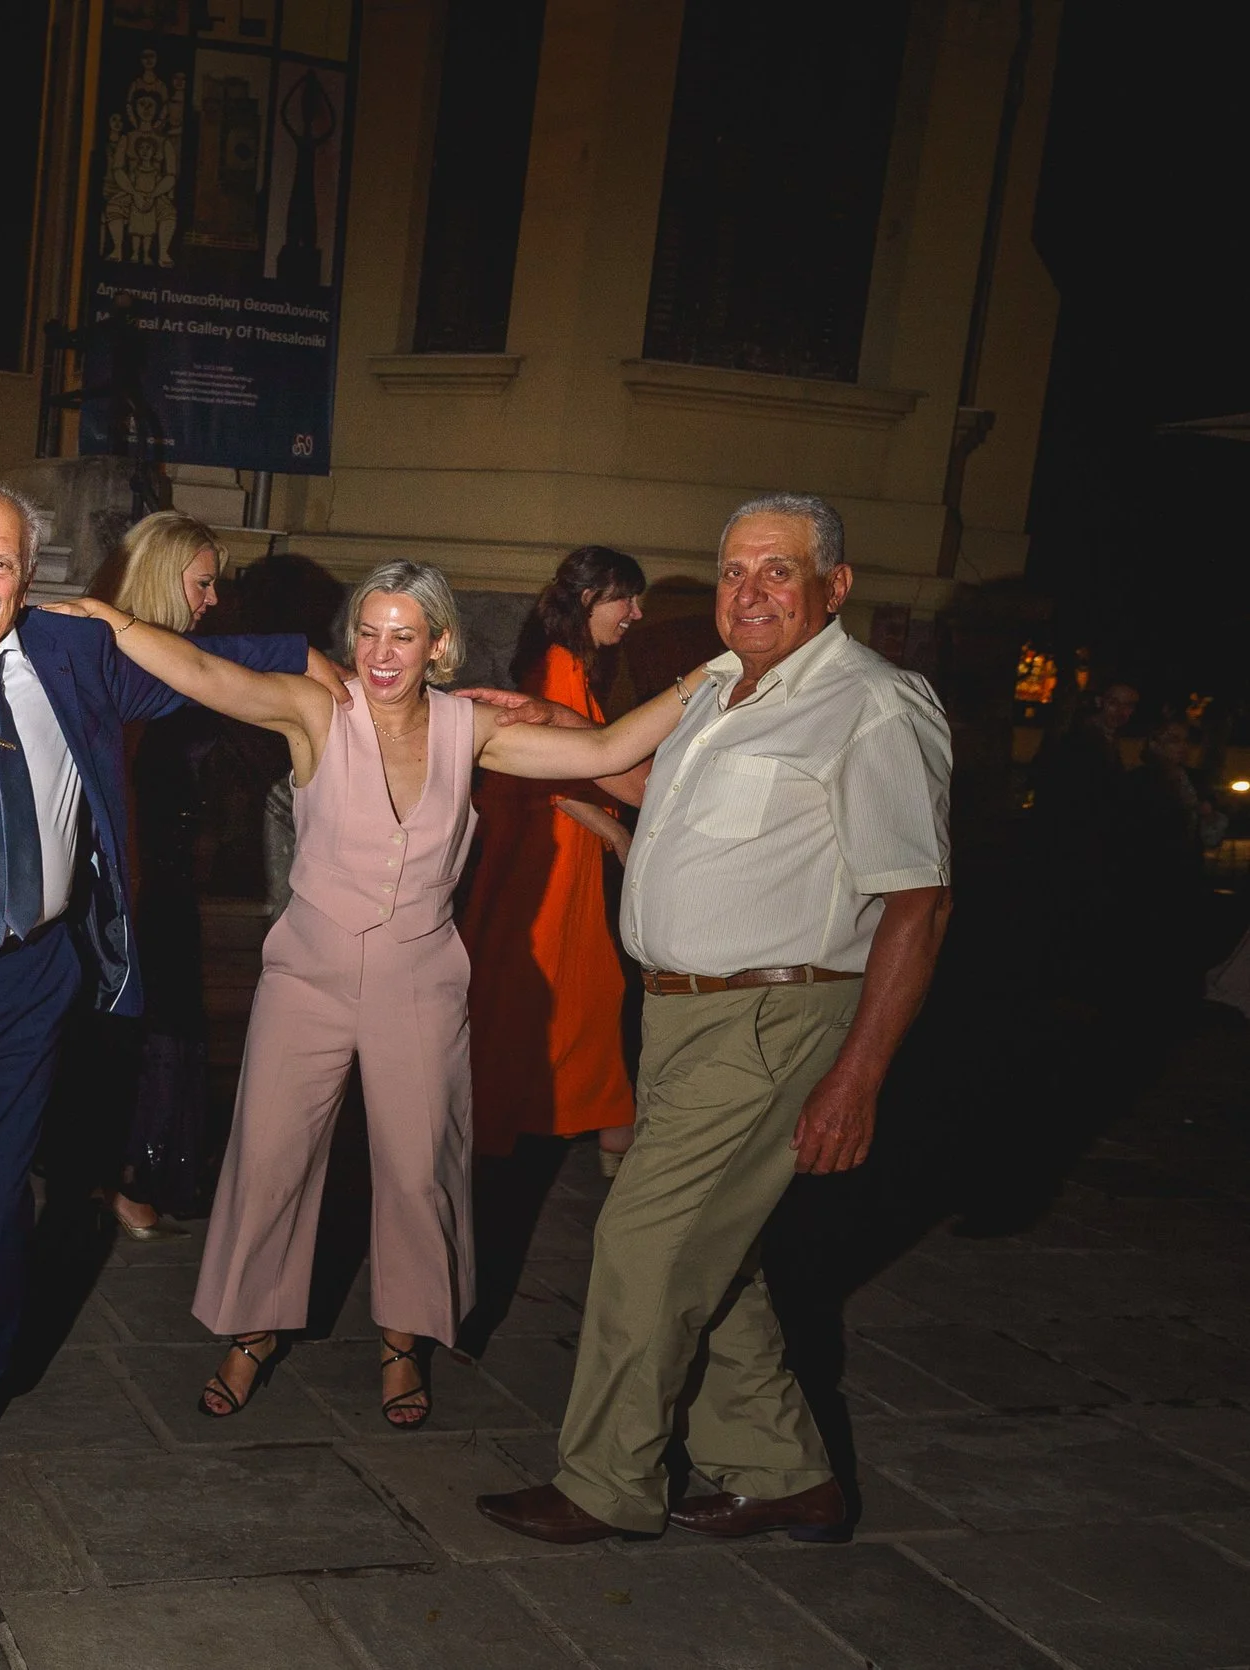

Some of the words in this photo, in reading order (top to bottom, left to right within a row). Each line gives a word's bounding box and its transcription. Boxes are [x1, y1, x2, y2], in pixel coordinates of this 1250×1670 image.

[161, 289, 240, 312] Πινακοθήκη
[243, 298, 330, 323] Θεσσαλονίκης
[161, 318, 184, 333] Art
[186, 320, 233, 340] Gallery
[235, 324, 254, 339] Of
[254, 326, 327, 349] Thessaloniki
